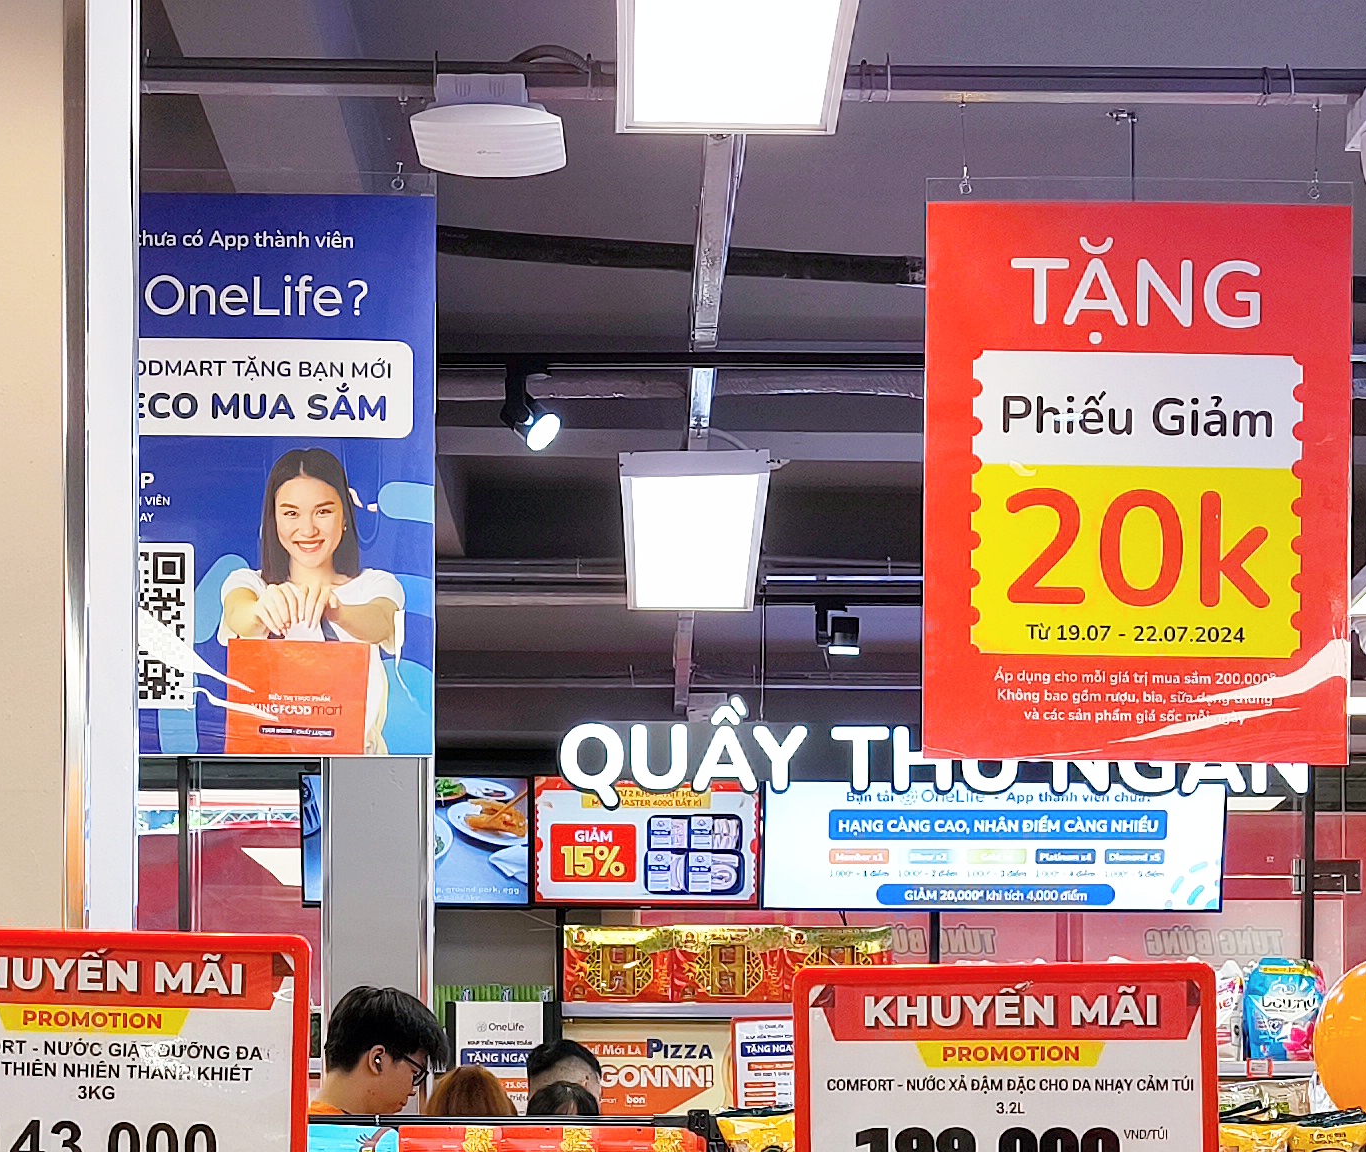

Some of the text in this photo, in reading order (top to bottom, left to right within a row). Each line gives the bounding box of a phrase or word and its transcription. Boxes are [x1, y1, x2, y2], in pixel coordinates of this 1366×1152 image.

[183, 230, 354, 251] có App thành viên
[145, 275, 368, 316] OneLife?
[1011, 236, 1262, 345] TẶNG
[232, 355, 391, 381] TẶNG BẠN MỚI
[212, 393, 295, 420] MUA
[308, 383, 386, 421] SẮM
[1001, 391, 1273, 437] Phiếu Giảm
[1006, 487, 1271, 608] 20k
[1026, 624, 1050, 642] Từ
[1057, 625, 1111, 642] 19.07
[1134, 625, 1246, 644] 22.07.2024
[1017, 670, 1050, 684] dụng
[1055, 670, 1077, 683] cho
[1082, 669, 1105, 684] mỗi
[1152, 673, 1181, 685] mua
[1185, 670, 1211, 685] sắm
[558, 696, 808, 810] QUẦY
[575, 827, 613, 843] GIẢM
[838, 818, 883, 836] HẠNG
[887, 816, 931, 834] CÀNG
[934, 819, 970, 836] CAO,
[973, 817, 1019, 834] NHÂN
[1064, 817, 1107, 834] CÀNG
[561, 846, 625, 877] 15%
[154, 954, 244, 996] MÃI
[863, 981, 1158, 1028] KHUYẾN MÃI
[22, 1011, 163, 1029] PROMOTION
[489, 1022, 525, 1032] OneLife
[44, 1037, 103, 1057] NƯỚC
[942, 1046, 1080, 1062] PROMOTION
[2, 1058, 57, 1077] THIÊN
[63, 1059, 120, 1078] NHIÊN
[467, 1051, 497, 1066] TẶNG
[78, 1085, 115, 1101] 3KG
[826, 1073, 1194, 1094] COMFORT NƯỚC XẢ ĐẬM ĐẶC CHO DA NHẠY CẢM TÚI
[996, 1101, 1025, 1115] 3.2L
